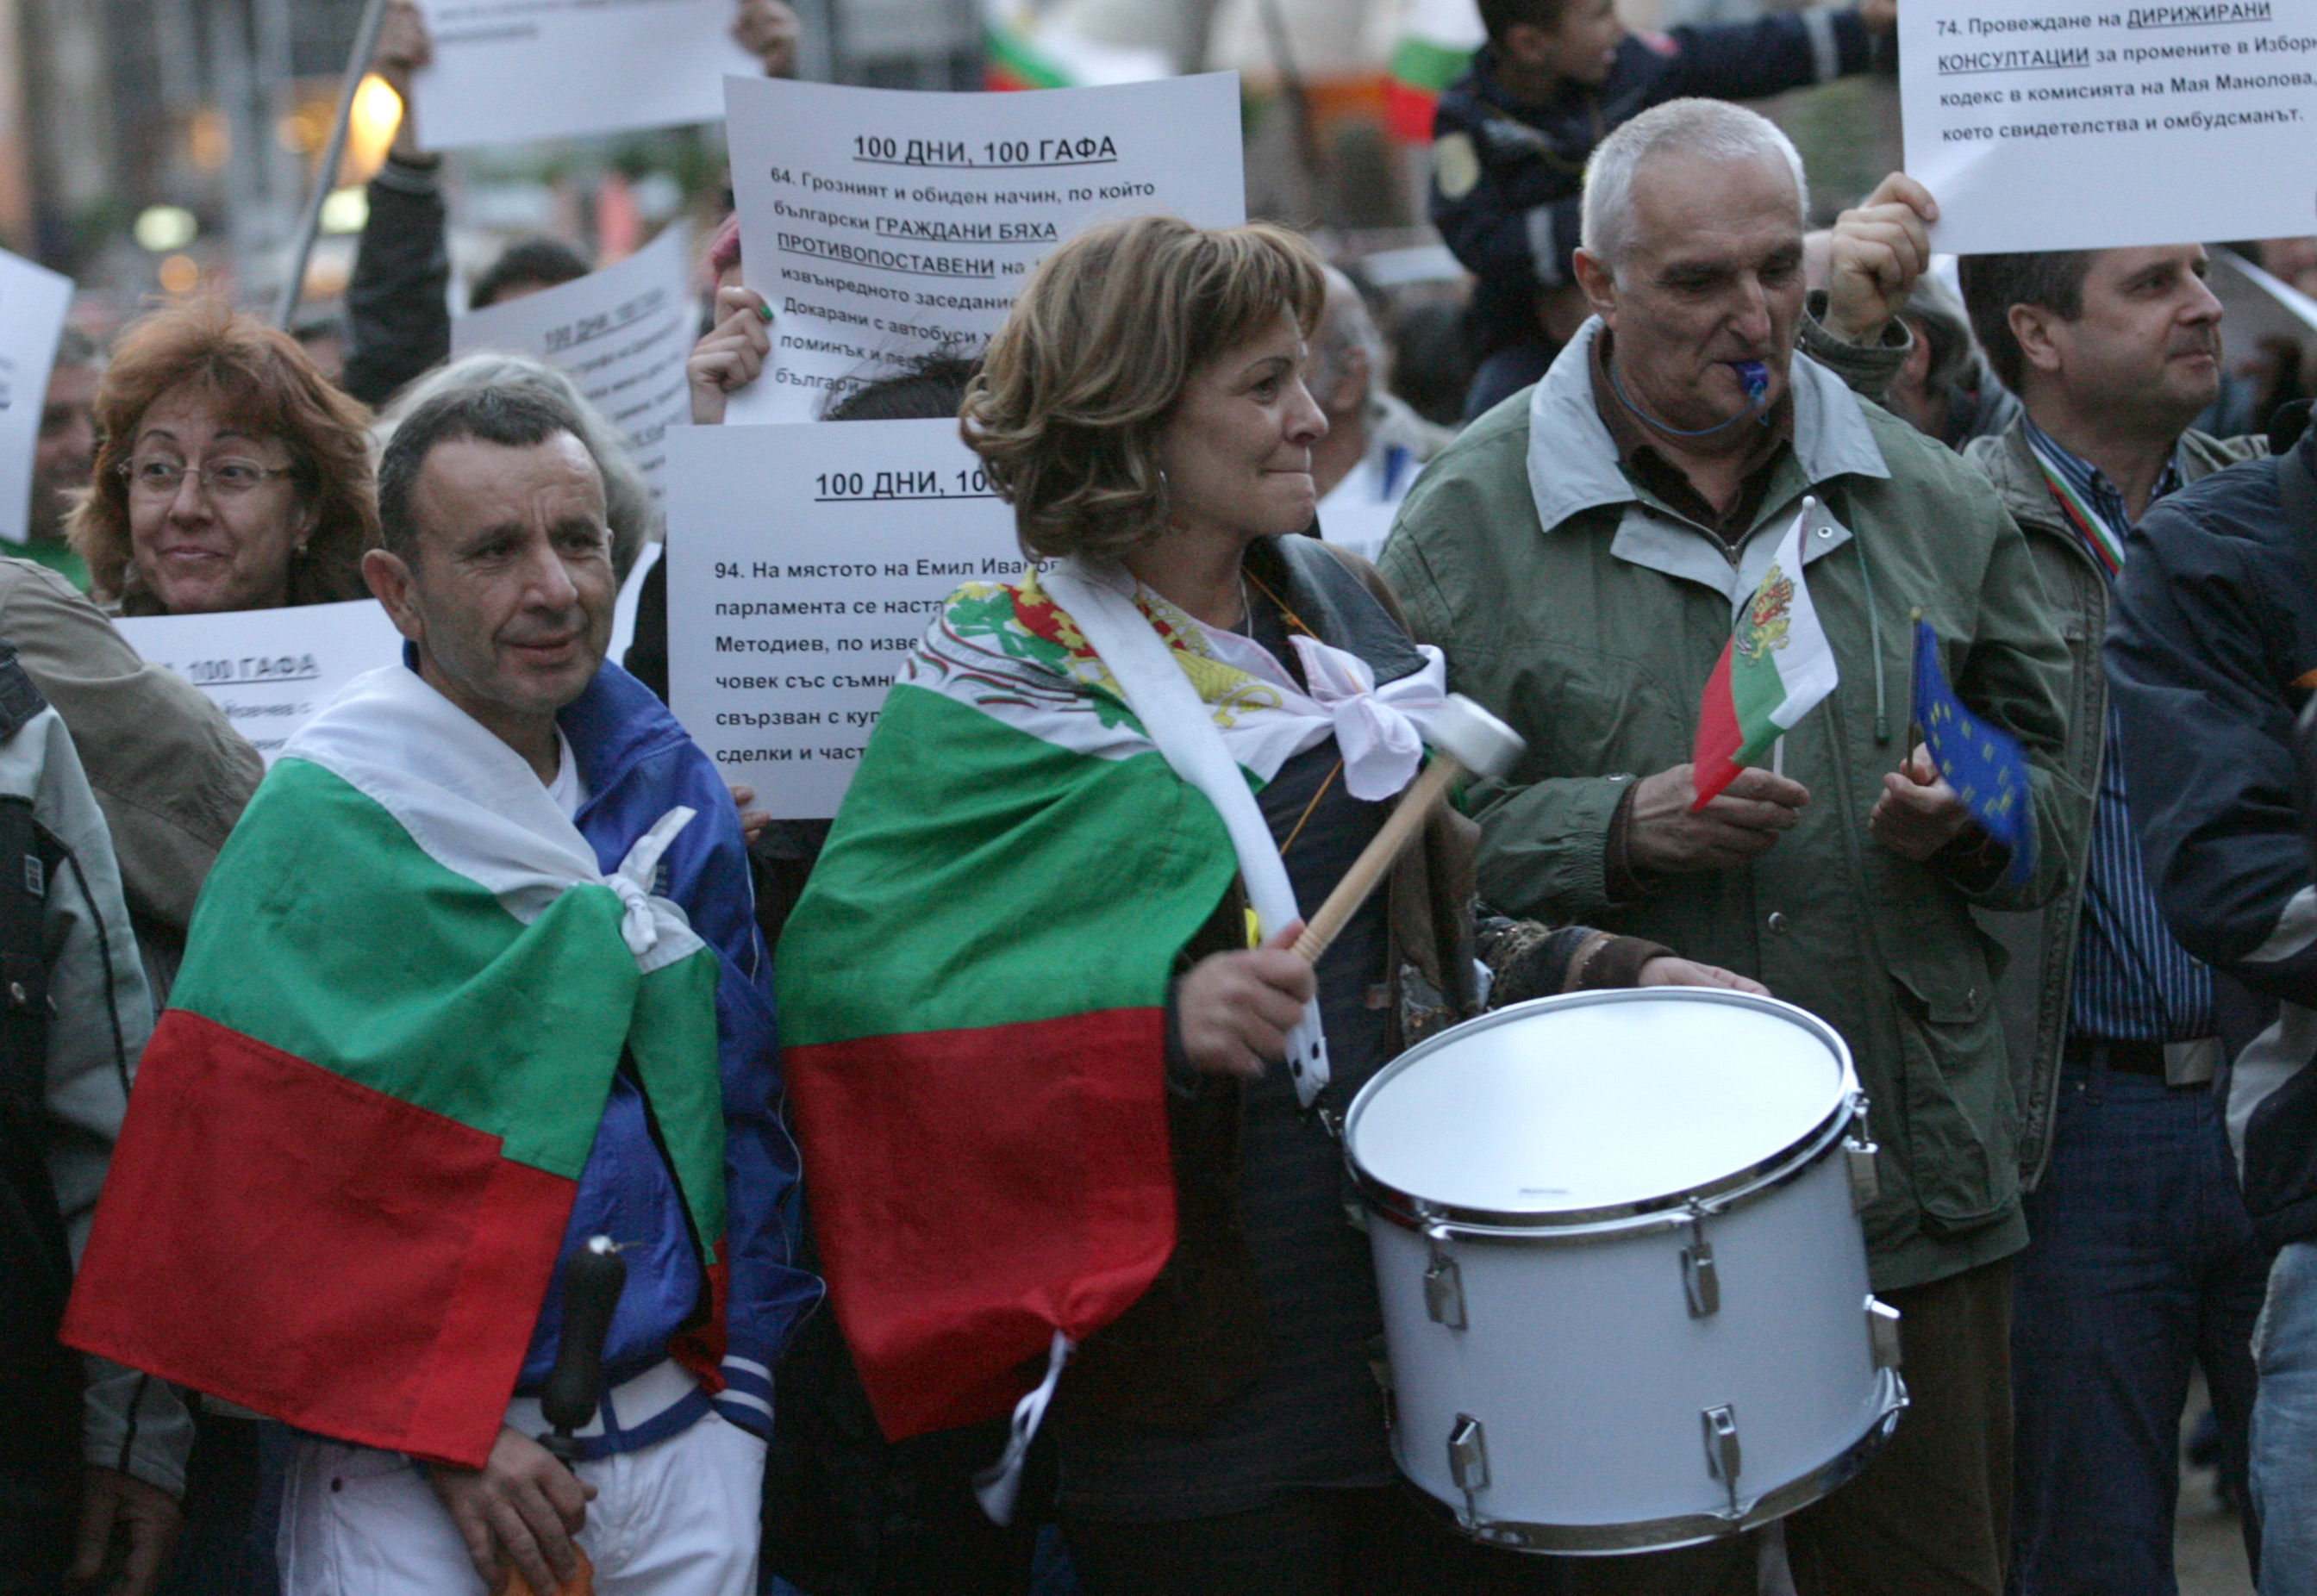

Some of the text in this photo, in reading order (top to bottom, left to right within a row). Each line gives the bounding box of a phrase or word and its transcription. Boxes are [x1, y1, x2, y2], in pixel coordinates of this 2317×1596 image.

[1936, 2, 2271, 38] 74. Провеждане на ДИРИЖИРАНИ
[1938, 48, 2090, 72] КОНСУЛТАЦИИ
[2095, 49, 2117, 63] за
[2123, 42, 2231, 63] промените
[2238, 41, 2248, 53] в
[1939, 89, 2004, 107] кодекс
[2010, 88, 2021, 103] в
[2028, 82, 2135, 102] комисията
[2141, 82, 2164, 95] на
[2170, 77, 2209, 93] Мая
[1942, 108, 2304, 141] което свидетелства и омбудсманът.
[853, 135, 1117, 166] 100 ДНИ, 100 ГАФА
[771, 167, 1155, 205] 64. Грозният и обиден начин, по който
[774, 201, 1058, 240] български ГРАЖДАНИ БЯХА
[778, 233, 1026, 276] ПРОТИВОПОСТАВЕНИ на
[781, 267, 909, 302] извънредното
[784, 297, 868, 326] Докарани
[874, 317, 884, 329] с
[889, 320, 977, 345] автобуси
[781, 335, 864, 359] поминък
[870, 348, 880, 361] и
[815, 473, 863, 496] 100
[873, 471, 945, 498] ДНИ,
[715, 562, 745, 579] 94.
[753, 562, 780, 579] На
[787, 564, 877, 579] мястото
[884, 564, 909, 577] на
[917, 560, 974, 577] Емил
[715, 600, 846, 620] парламента
[852, 601, 877, 614] се
[715, 636, 830, 656] Методиев,
[837, 639, 864, 651] по
[716, 676, 779, 690] човек
[785, 675, 825, 689] със
[716, 711, 821, 731] свързван
[828, 710, 840, 724] с
[716, 746, 792, 764] сделки
[800, 747, 812, 761] и
